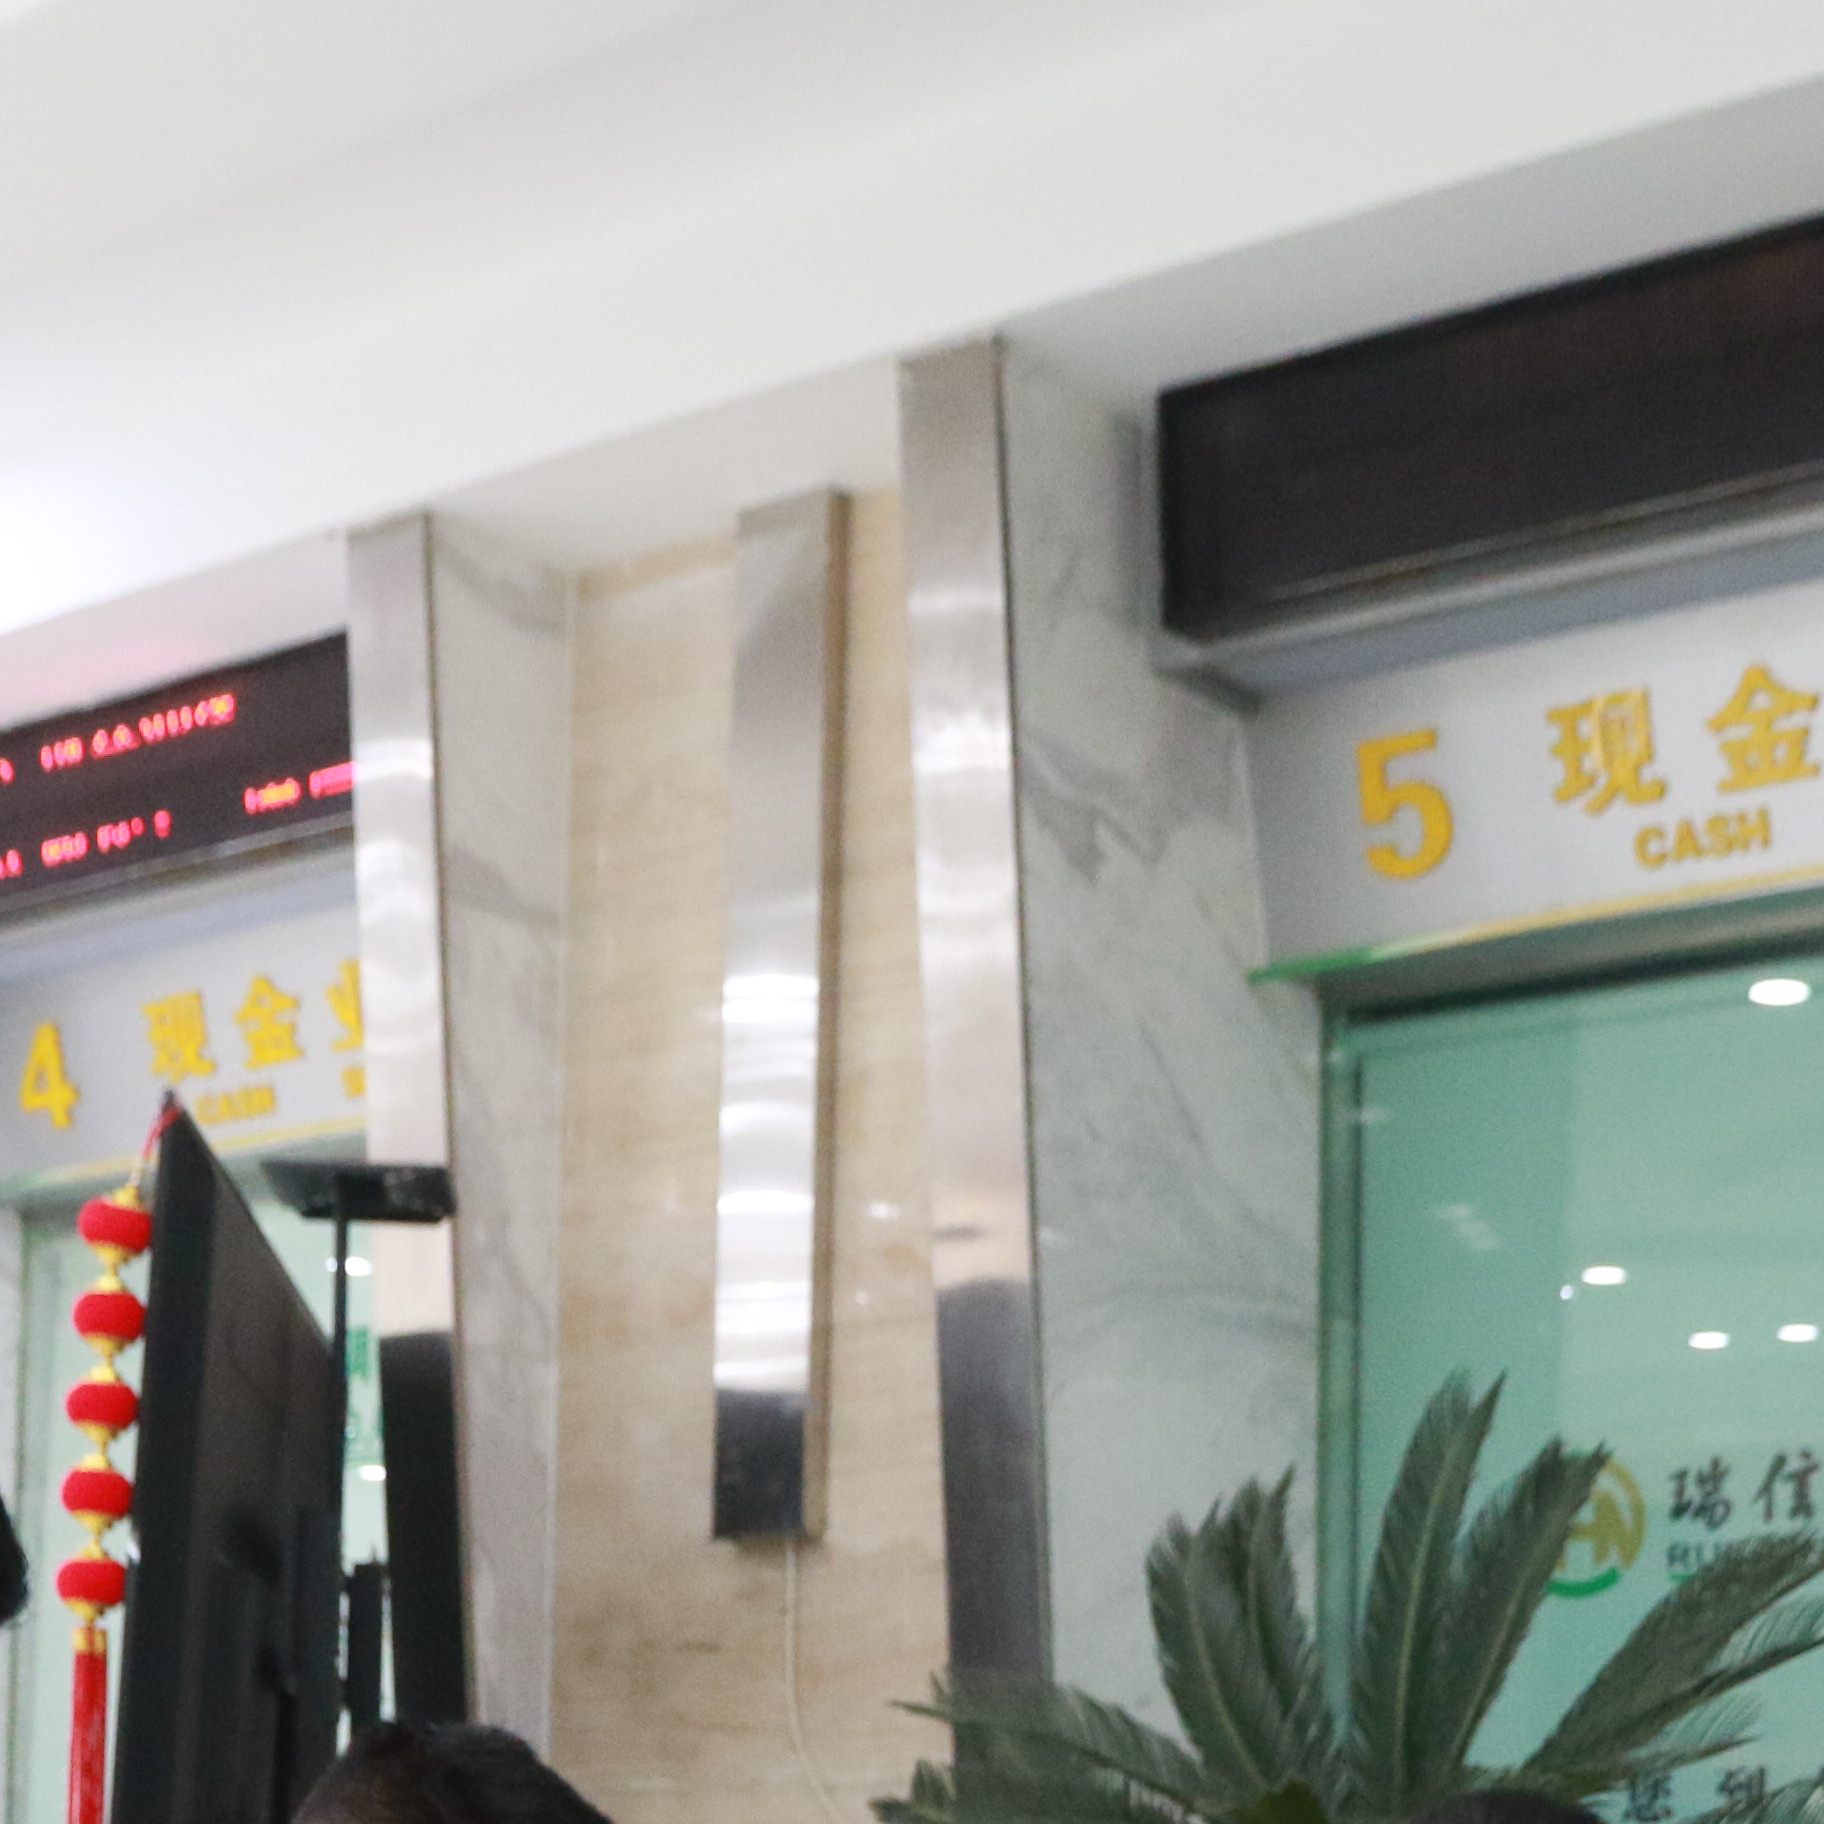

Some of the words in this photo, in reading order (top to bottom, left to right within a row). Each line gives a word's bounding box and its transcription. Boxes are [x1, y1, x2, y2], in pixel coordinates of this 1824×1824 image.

[1356, 729, 1454, 878] 5
[1634, 809, 1773, 869] CASH
[19, 1021, 80, 1130] 4
